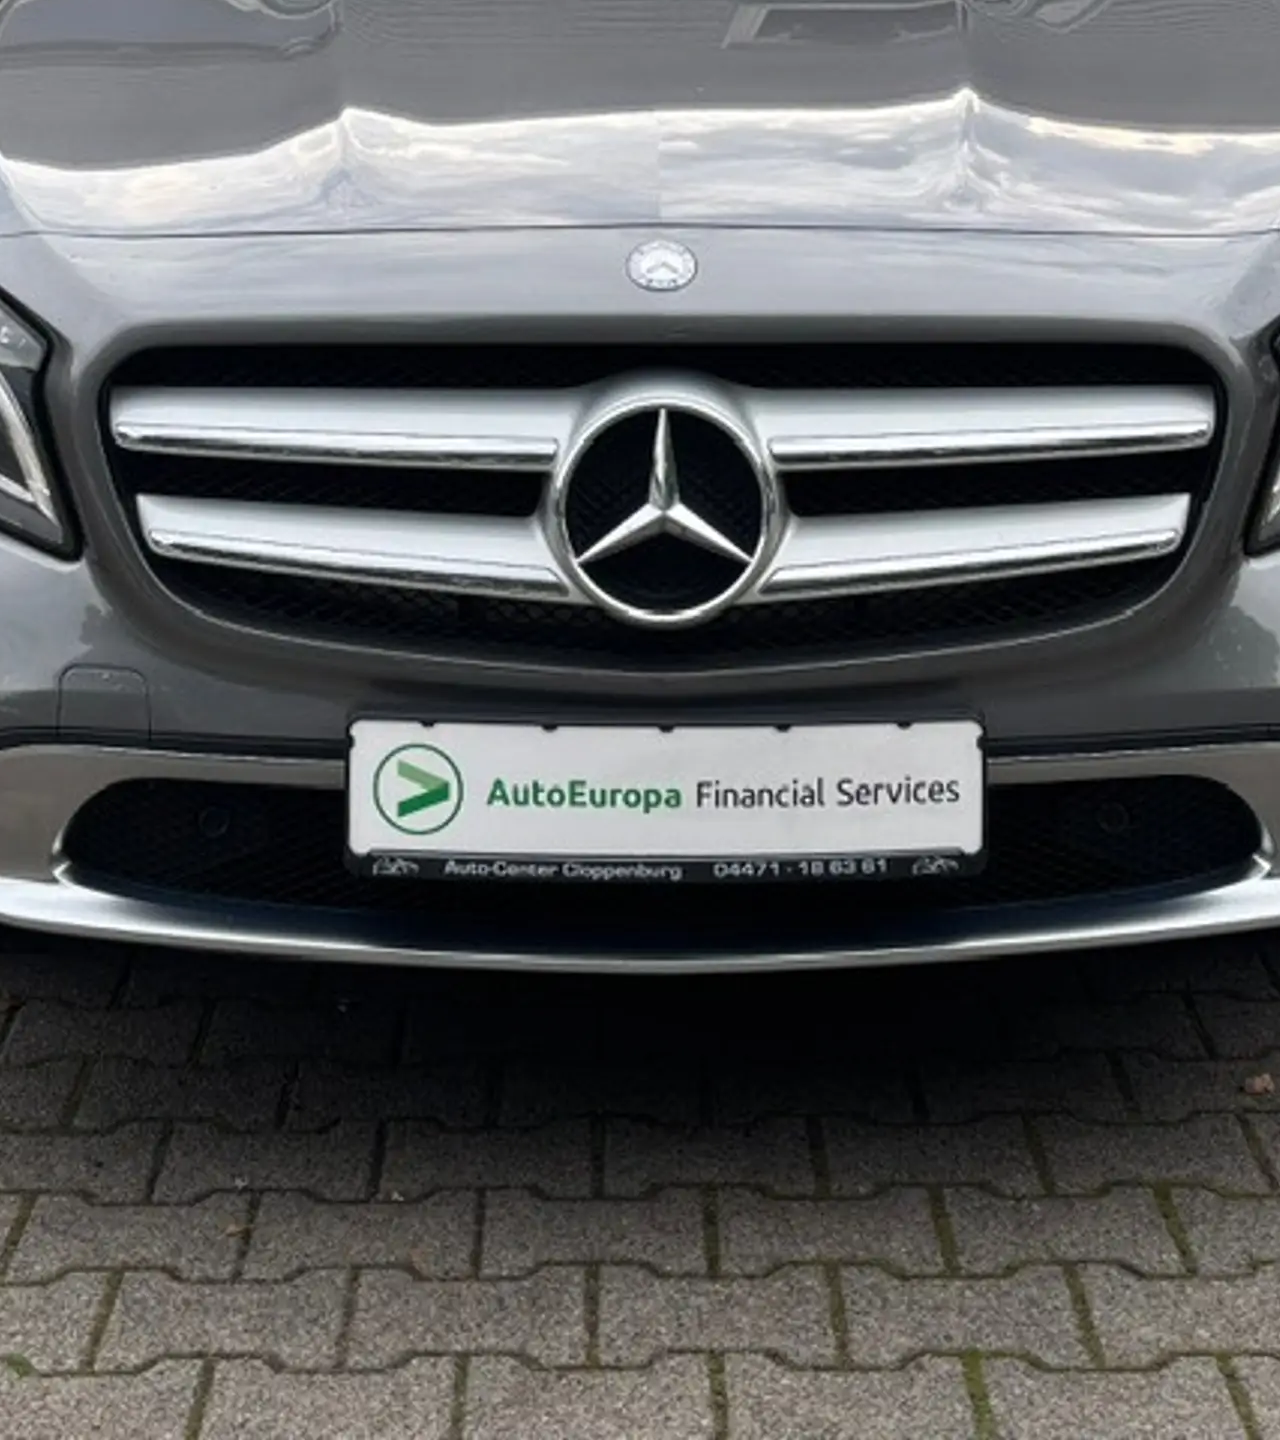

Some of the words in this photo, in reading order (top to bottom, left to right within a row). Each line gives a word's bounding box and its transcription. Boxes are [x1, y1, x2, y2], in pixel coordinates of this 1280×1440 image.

[486, 778, 682, 814] AutoEuropa
[696, 776, 824, 809] Financial
[837, 776, 960, 806] Services
[444, 861, 558, 877] Auto-Center
